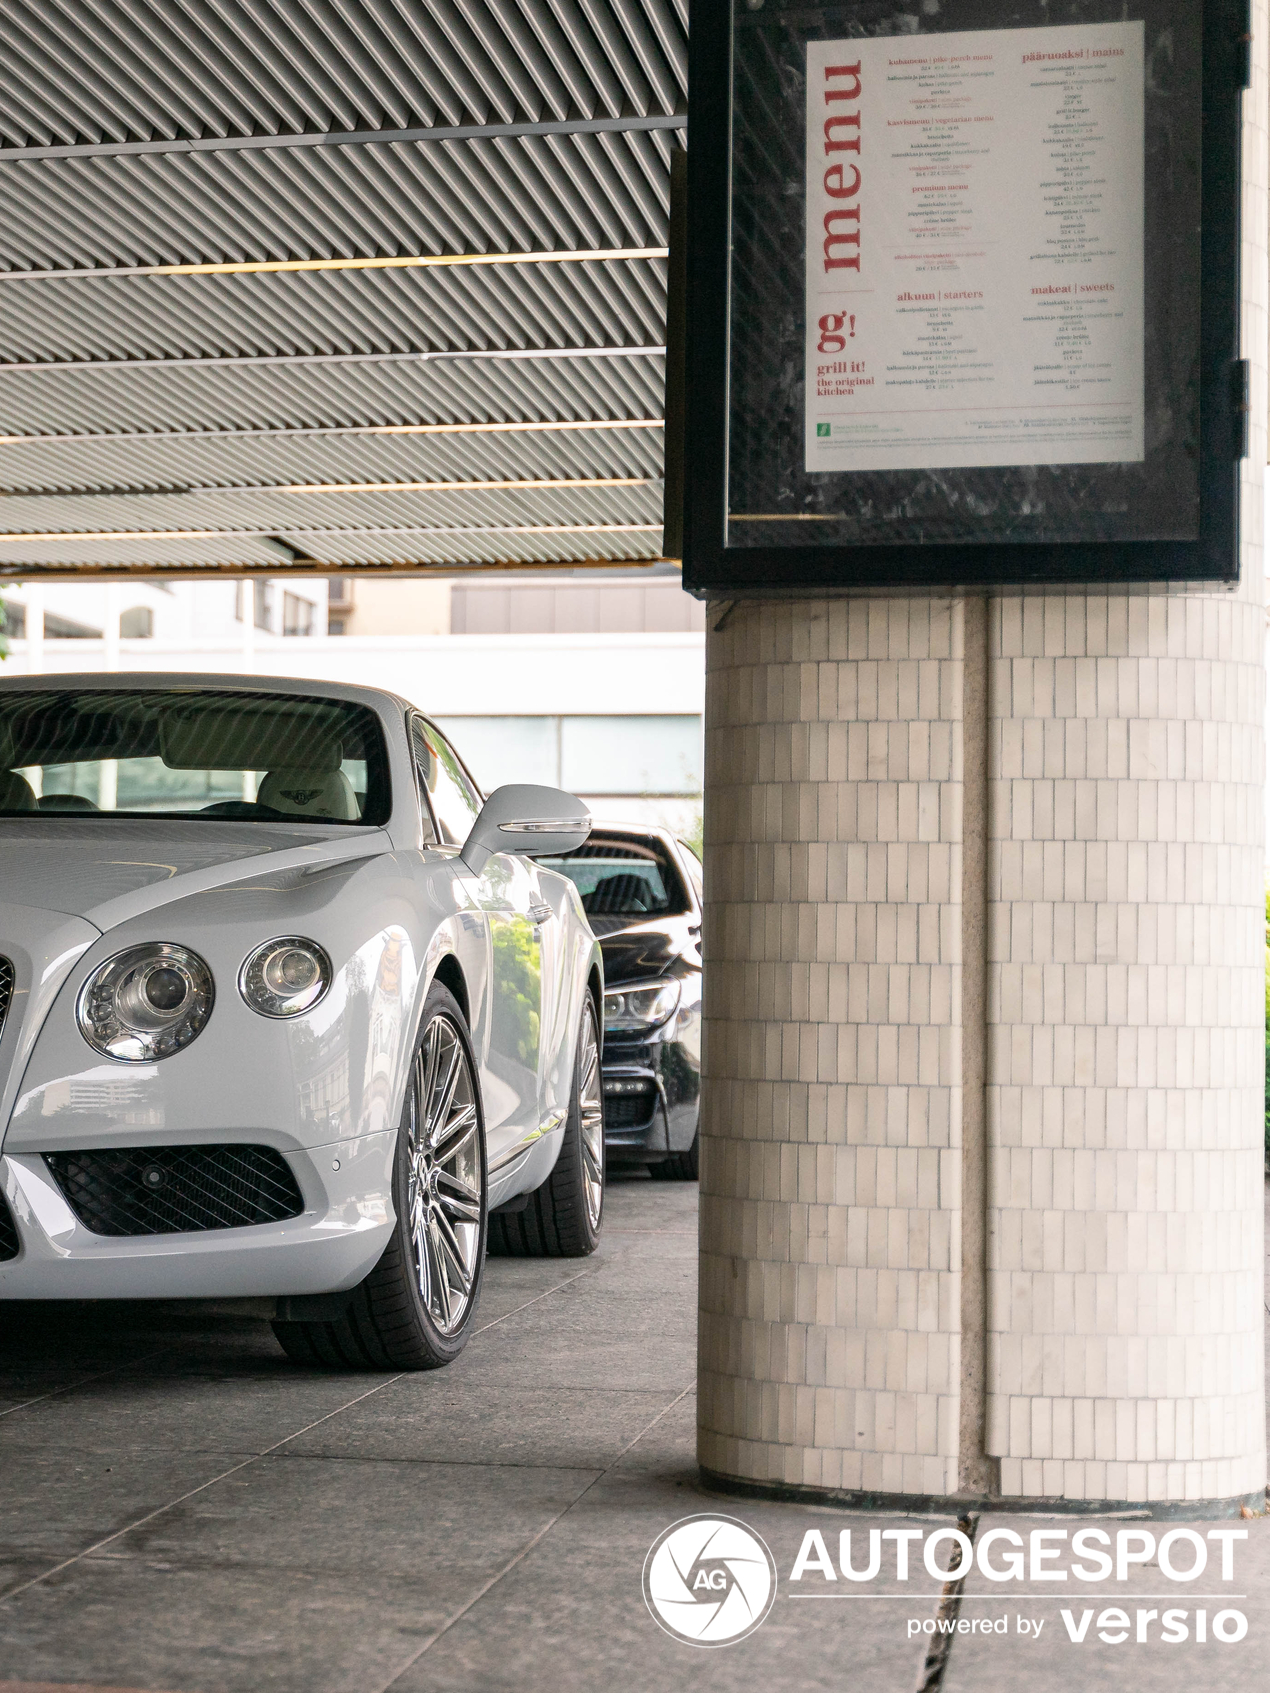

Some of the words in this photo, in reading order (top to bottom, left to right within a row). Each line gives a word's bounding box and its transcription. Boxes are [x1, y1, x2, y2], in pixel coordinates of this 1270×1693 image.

[1022, 49, 1084, 63] pääruoaksi
[1092, 48, 1124, 58] mains
[823, 59, 862, 274] menu
[912, 185, 946, 193] premium
[1031, 285, 1072, 295] makeat
[1080, 283, 1115, 292] sweets
[897, 292, 936, 301] alkuun
[943, 290, 984, 300] starters
[817, 310, 856, 354] g!
[817, 361, 847, 376] grill
[850, 360, 866, 373] it!
[817, 378, 833, 387] the
[835, 376, 875, 387] original
[817, 387, 854, 396] kitchen
